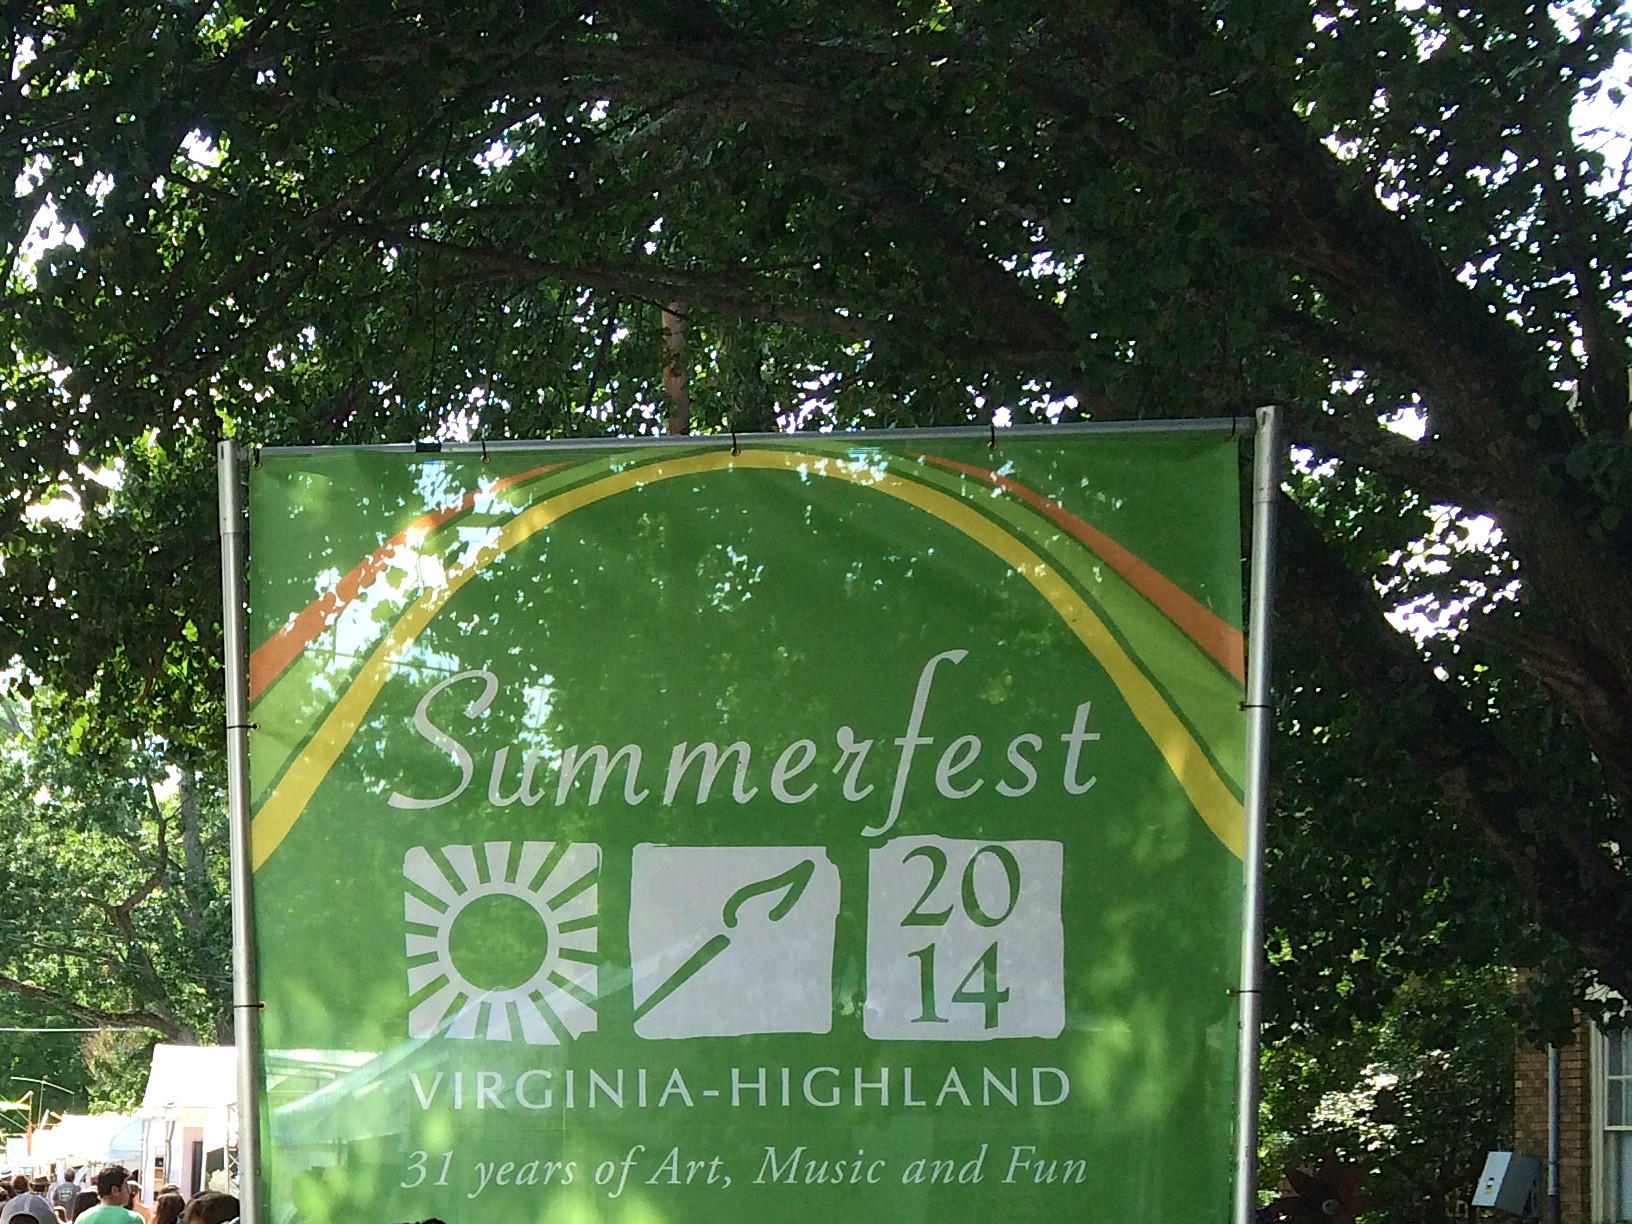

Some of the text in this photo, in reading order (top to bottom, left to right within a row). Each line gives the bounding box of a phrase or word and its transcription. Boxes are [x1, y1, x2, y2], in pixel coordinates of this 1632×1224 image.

[387, 649, 1101, 837] Summerfest
[899, 844, 1021, 929] 20
[906, 942, 1010, 1030] 14
[408, 1066, 1071, 1110] VIRGINIA-HIGHLAND
[400, 1143, 1087, 1199] 31 years of Art, Music and Fun
